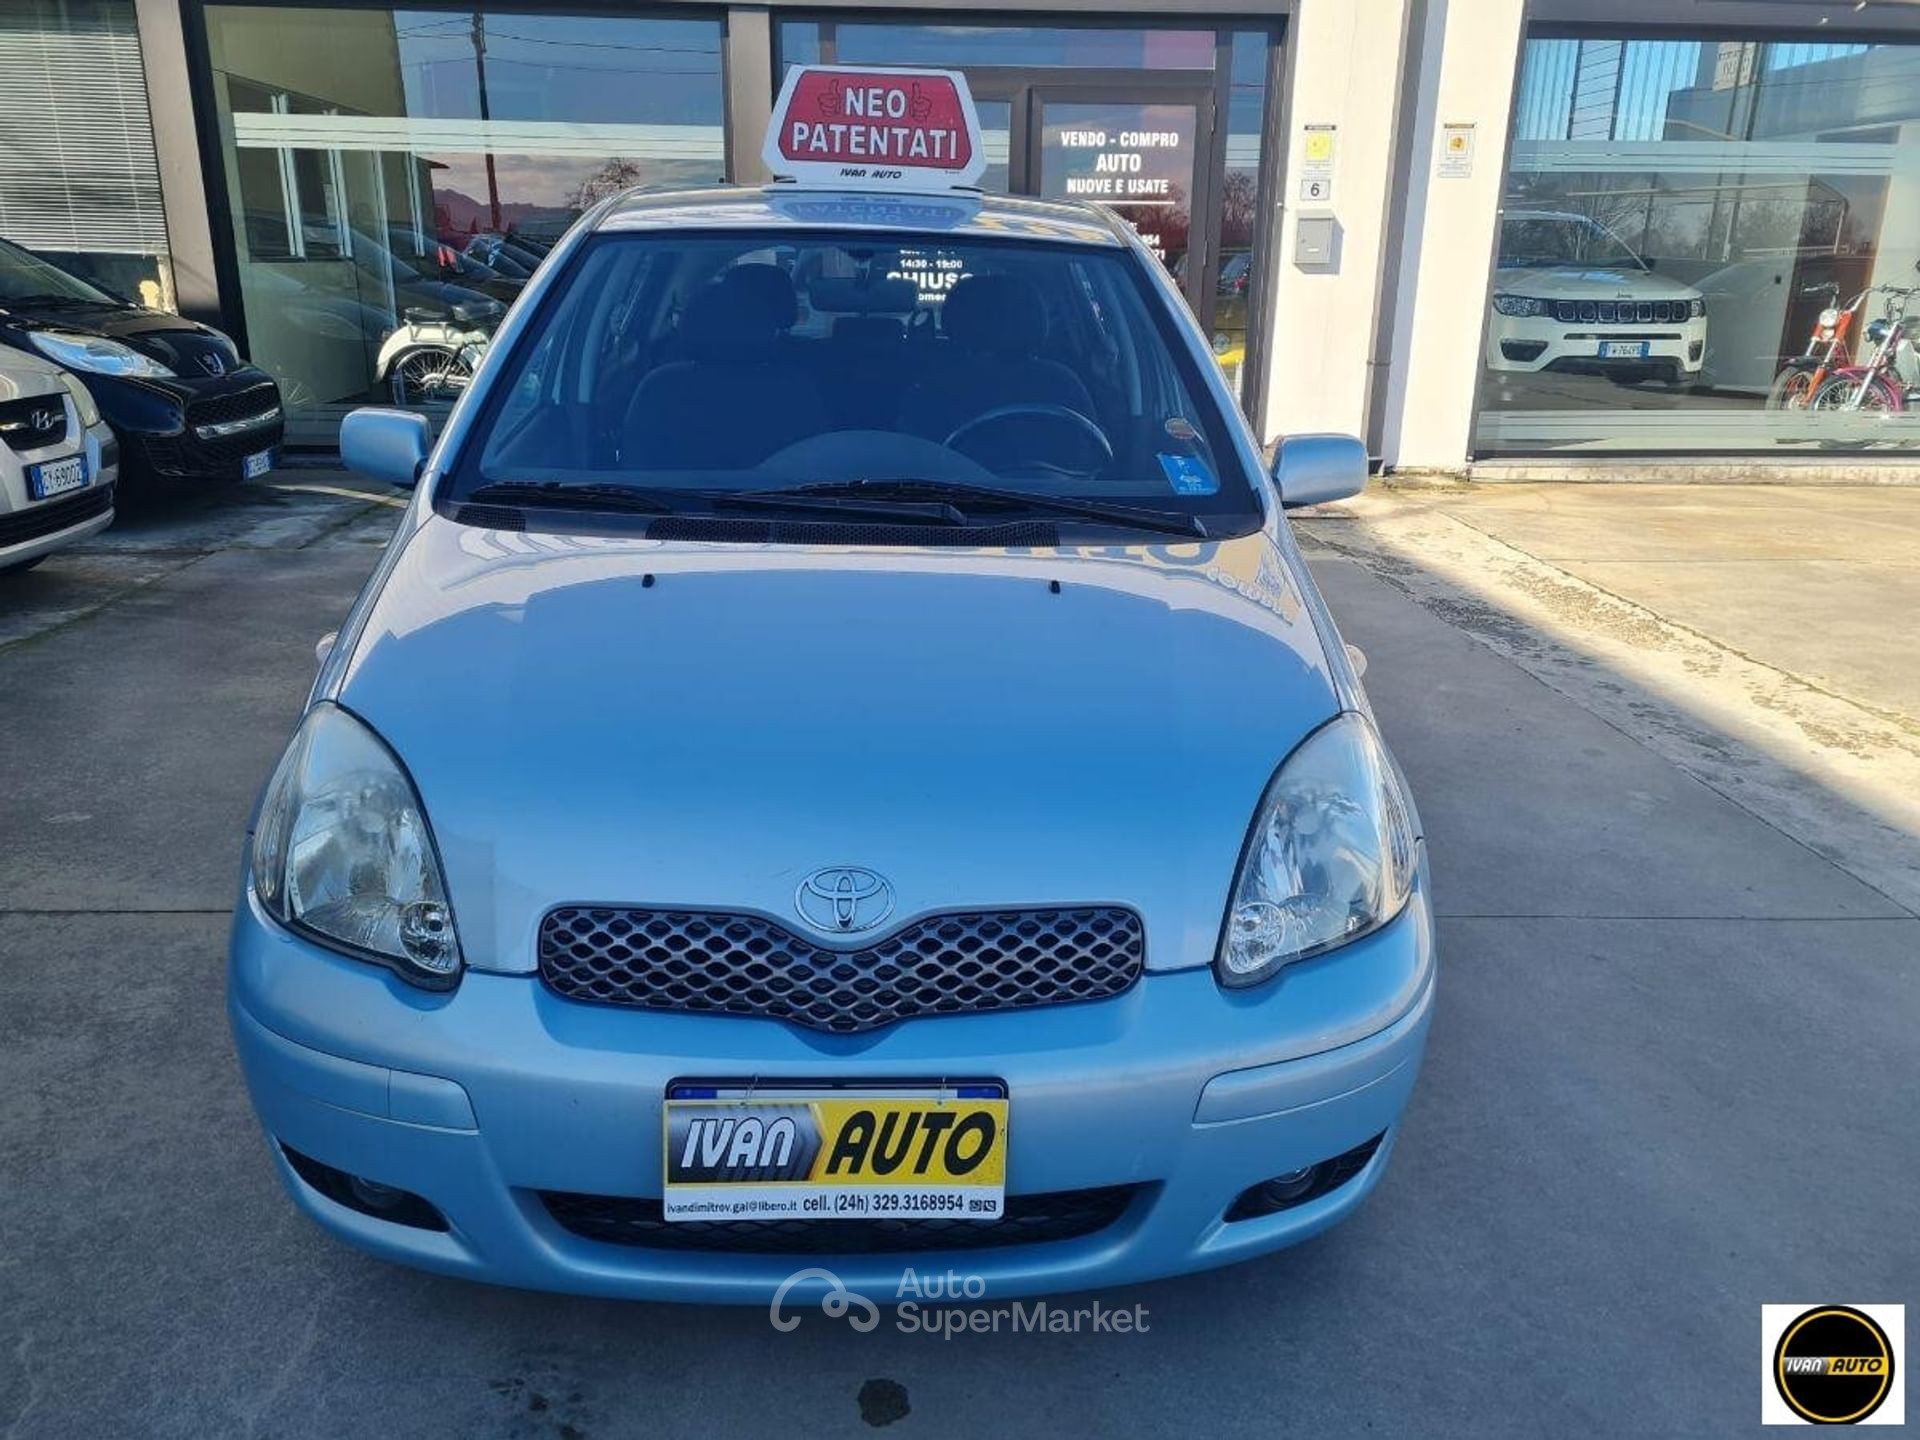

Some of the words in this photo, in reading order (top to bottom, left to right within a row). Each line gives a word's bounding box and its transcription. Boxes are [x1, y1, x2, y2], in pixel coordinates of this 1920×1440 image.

[845, 87, 906, 119] NEO
[792, 122, 957, 160] PATENTATI
[1061, 131, 1106, 147] VENDO
[1120, 132, 1179, 147] COMPRO
[1096, 153, 1142, 172] AUTO
[839, 168, 867, 178] IVAN
[872, 169, 902, 179] AUTO
[1067, 178, 1112, 194] NUOVE
[1116, 179, 1124, 193] E
[1127, 179, 1169, 194] USATE
[1310, 182, 1320, 197] 6
[681, 1116, 797, 1169] IVAN
[825, 1110, 997, 1176] AUTO
[803, 1194, 830, 1211] cell.
[833, 1194, 870, 1214] (24h)
[872, 1194, 964, 1211] 329.3168954
